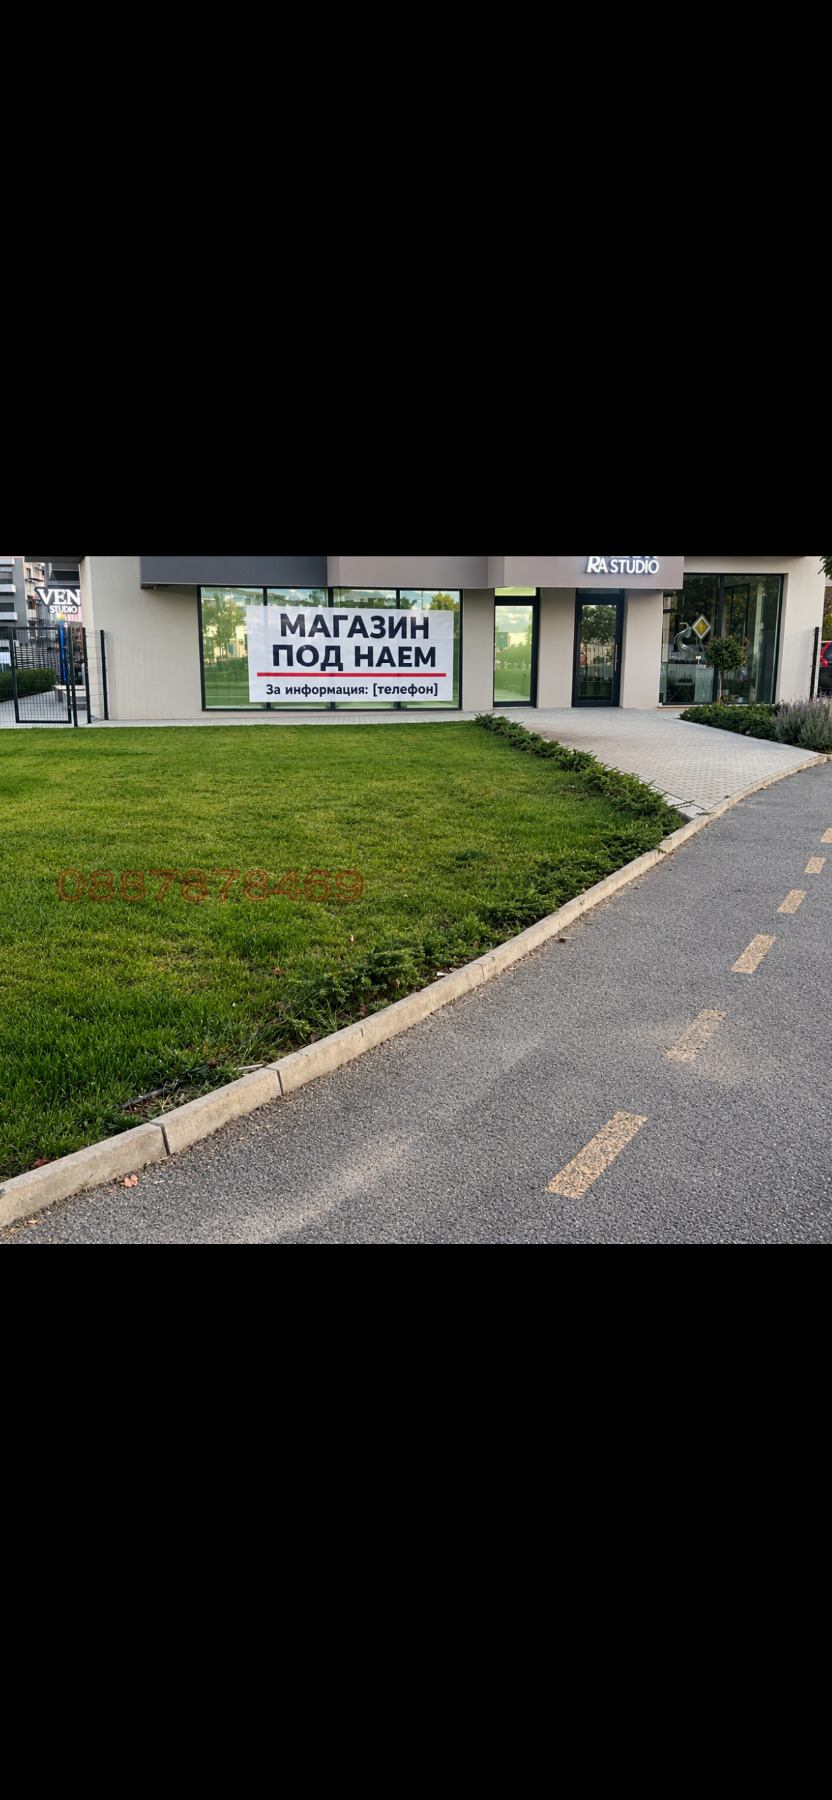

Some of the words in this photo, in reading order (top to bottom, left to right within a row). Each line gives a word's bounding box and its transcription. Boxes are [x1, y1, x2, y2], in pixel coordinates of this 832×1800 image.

[610, 559, 660, 574] STUDIO
[49, 605, 78, 614] STUDIO
[280, 613, 429, 639] МАГАЗИН
[272, 644, 344, 672] ПОД
[354, 645, 436, 668] НАЕМ
[266, 684, 281, 695] За
[285, 684, 368, 697] информация:
[373, 683, 438, 697] [телефон]
